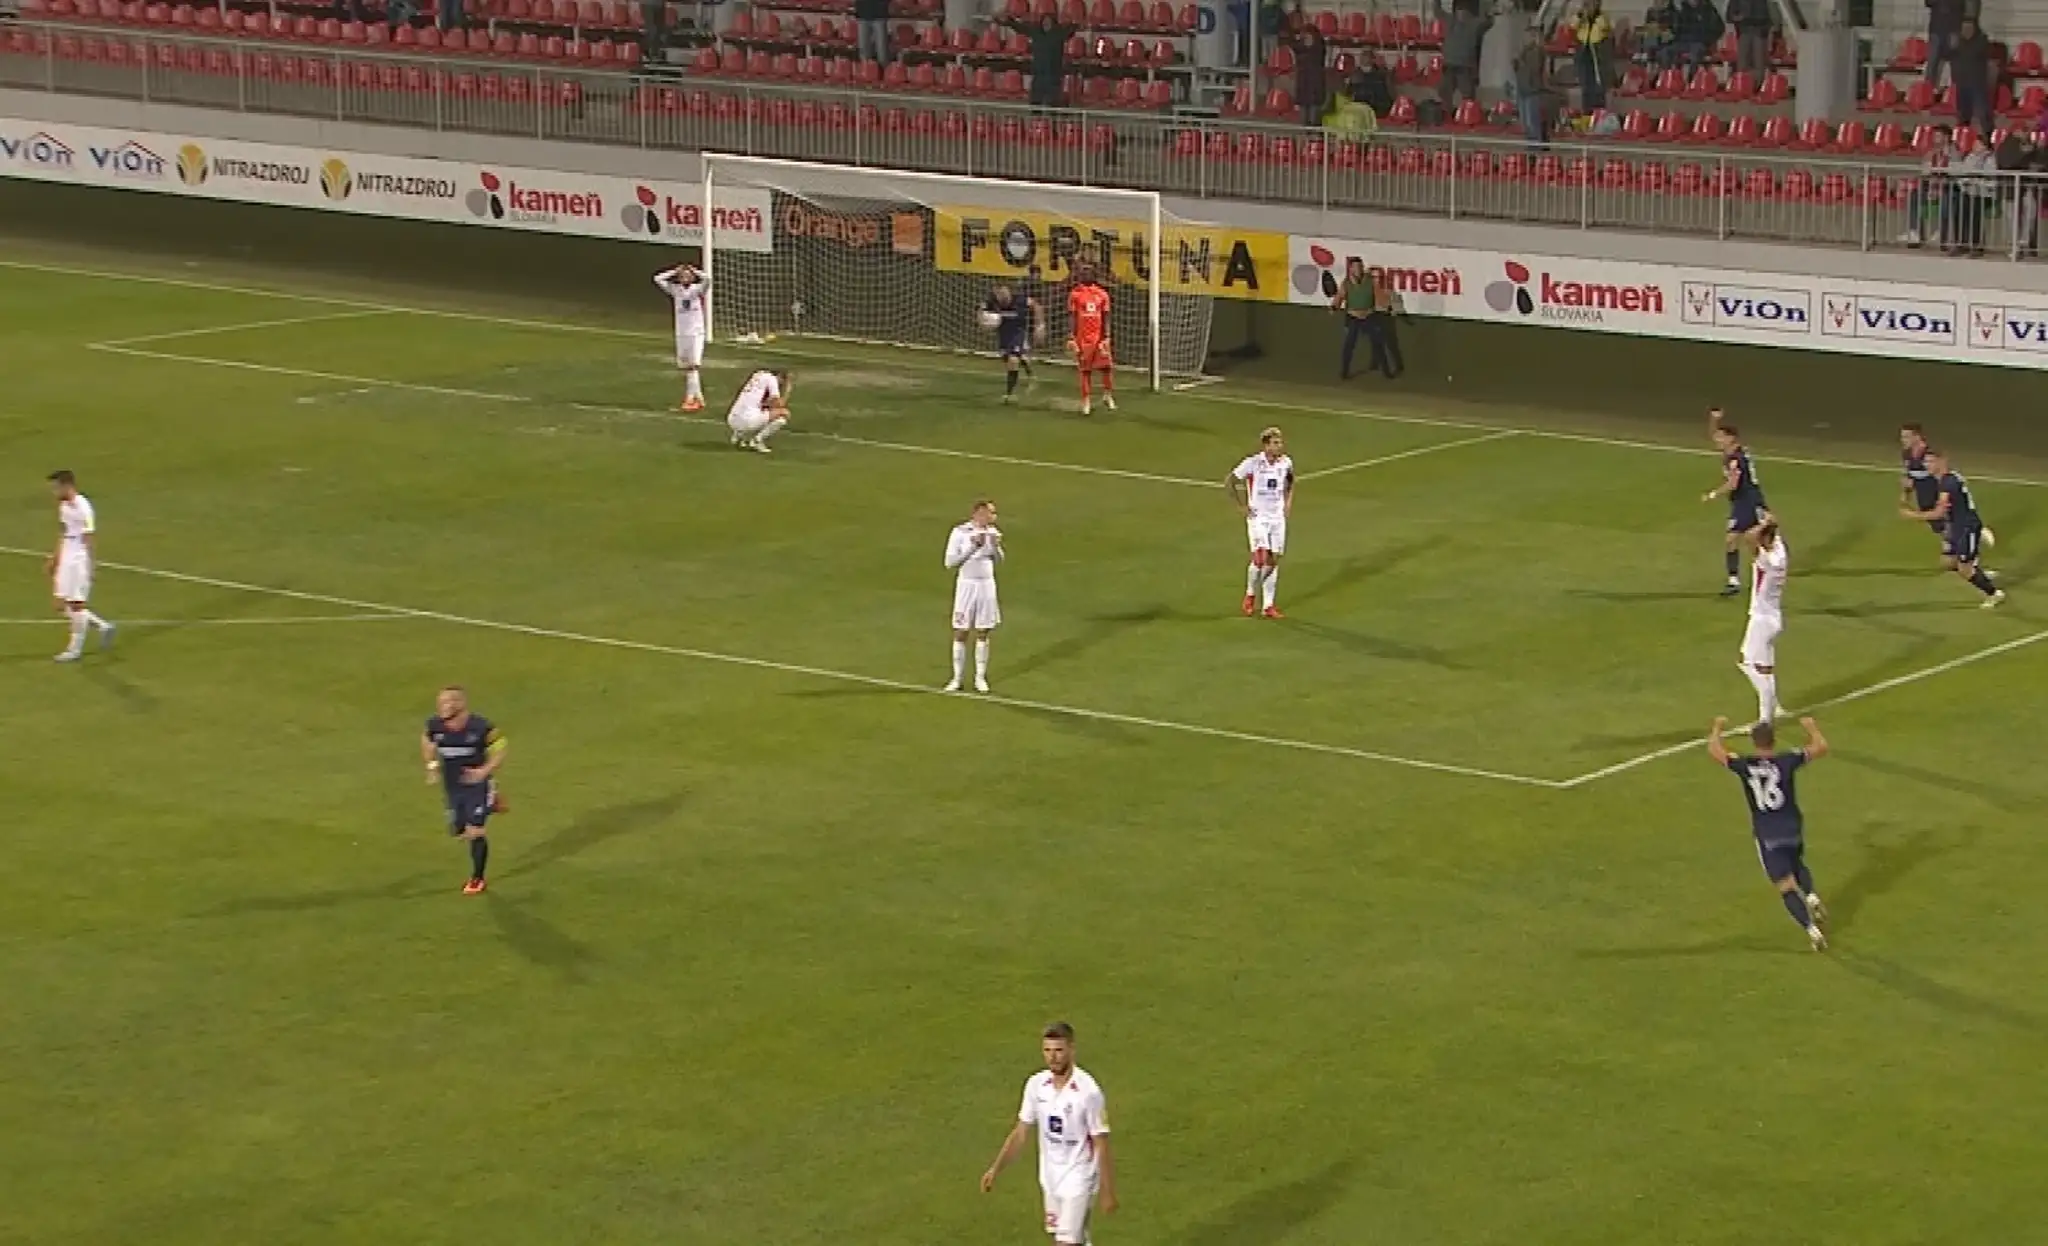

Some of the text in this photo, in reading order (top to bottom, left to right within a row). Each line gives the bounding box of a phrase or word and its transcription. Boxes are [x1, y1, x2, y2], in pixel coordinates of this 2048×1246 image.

[88, 147, 163, 175] ViOn
[213, 157, 310, 184] NITRAZDROJ
[356, 172, 456, 198] NITRAZDROJ
[509, 181, 603, 217] kameň
[961, 216, 1259, 290] FORTUNA
[1540, 272, 1664, 313] kameň
[1540, 305, 1603, 323] SLOVAKIA
[1718, 297, 1807, 323] ViOn
[1861, 310, 1952, 333] ViOn
